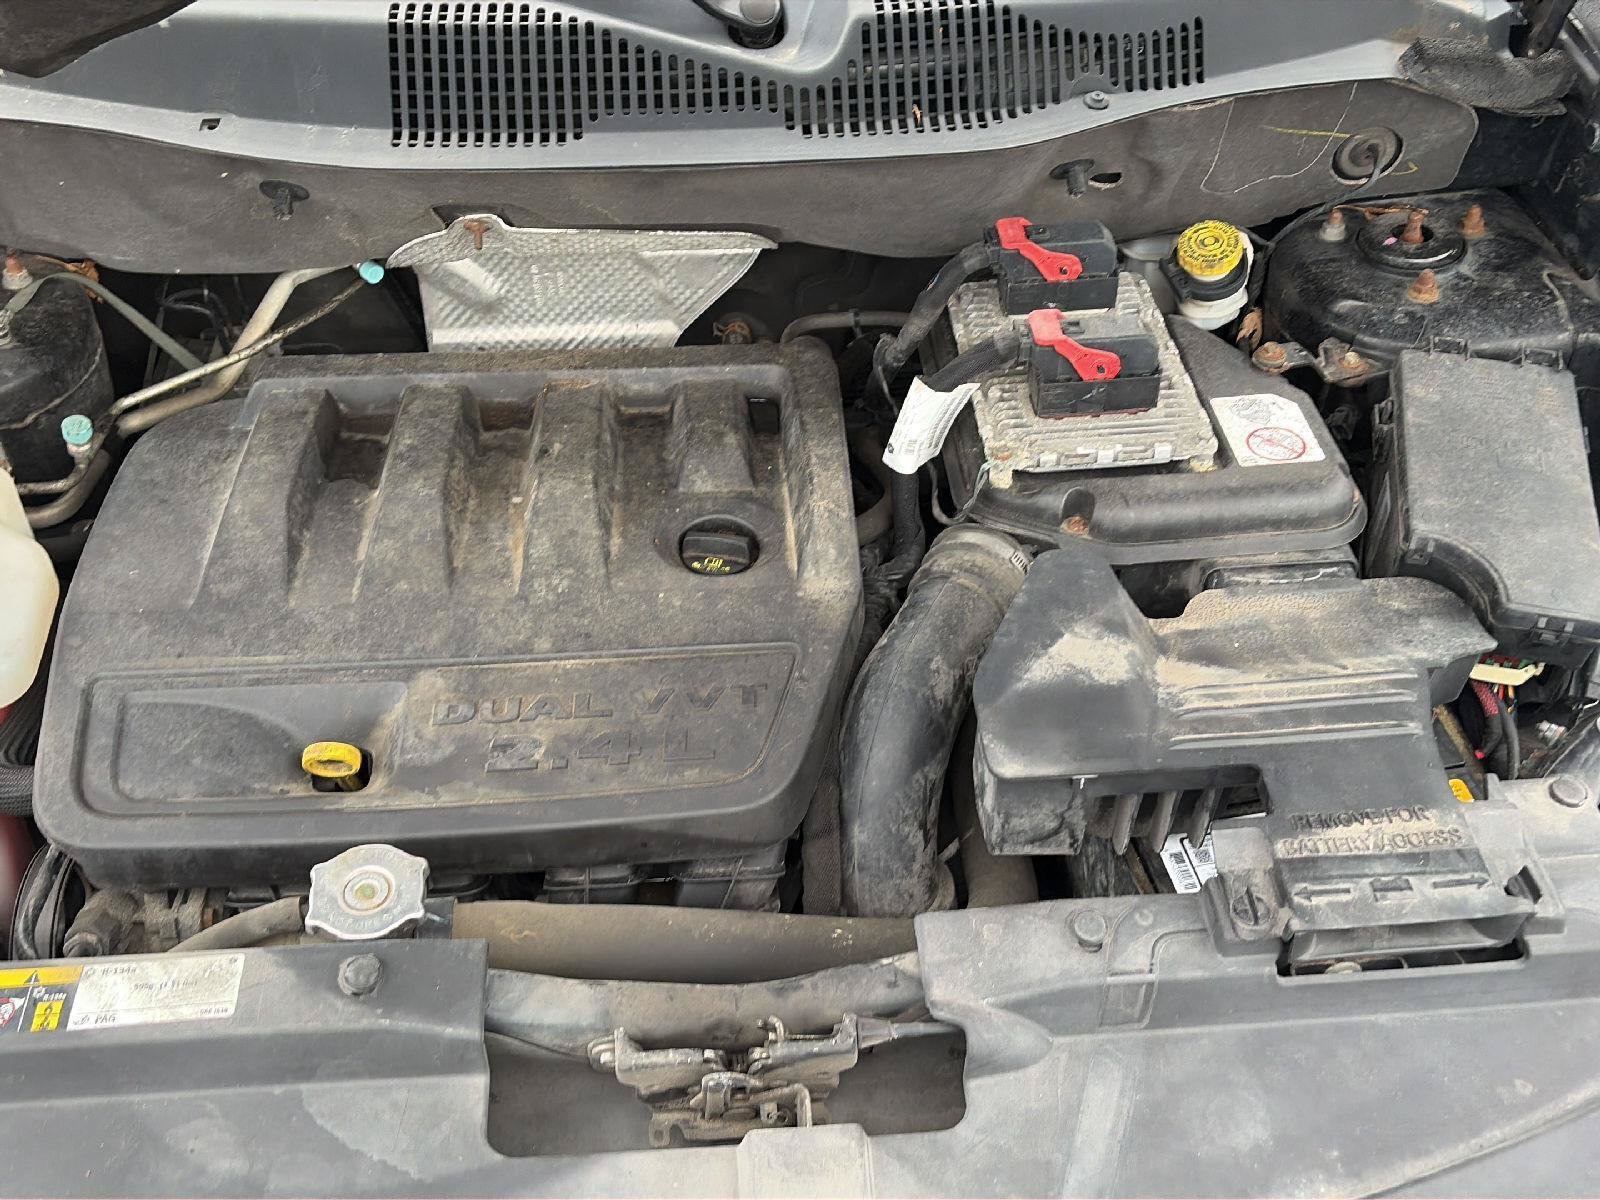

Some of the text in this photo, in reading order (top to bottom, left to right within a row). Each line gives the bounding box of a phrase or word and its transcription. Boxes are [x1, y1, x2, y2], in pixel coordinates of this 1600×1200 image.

[432, 683, 767, 726] DUAL VVT
[1289, 805, 1432, 830] REMOVE FOR
[1279, 827, 1464, 856] BATTERY ACCESS
